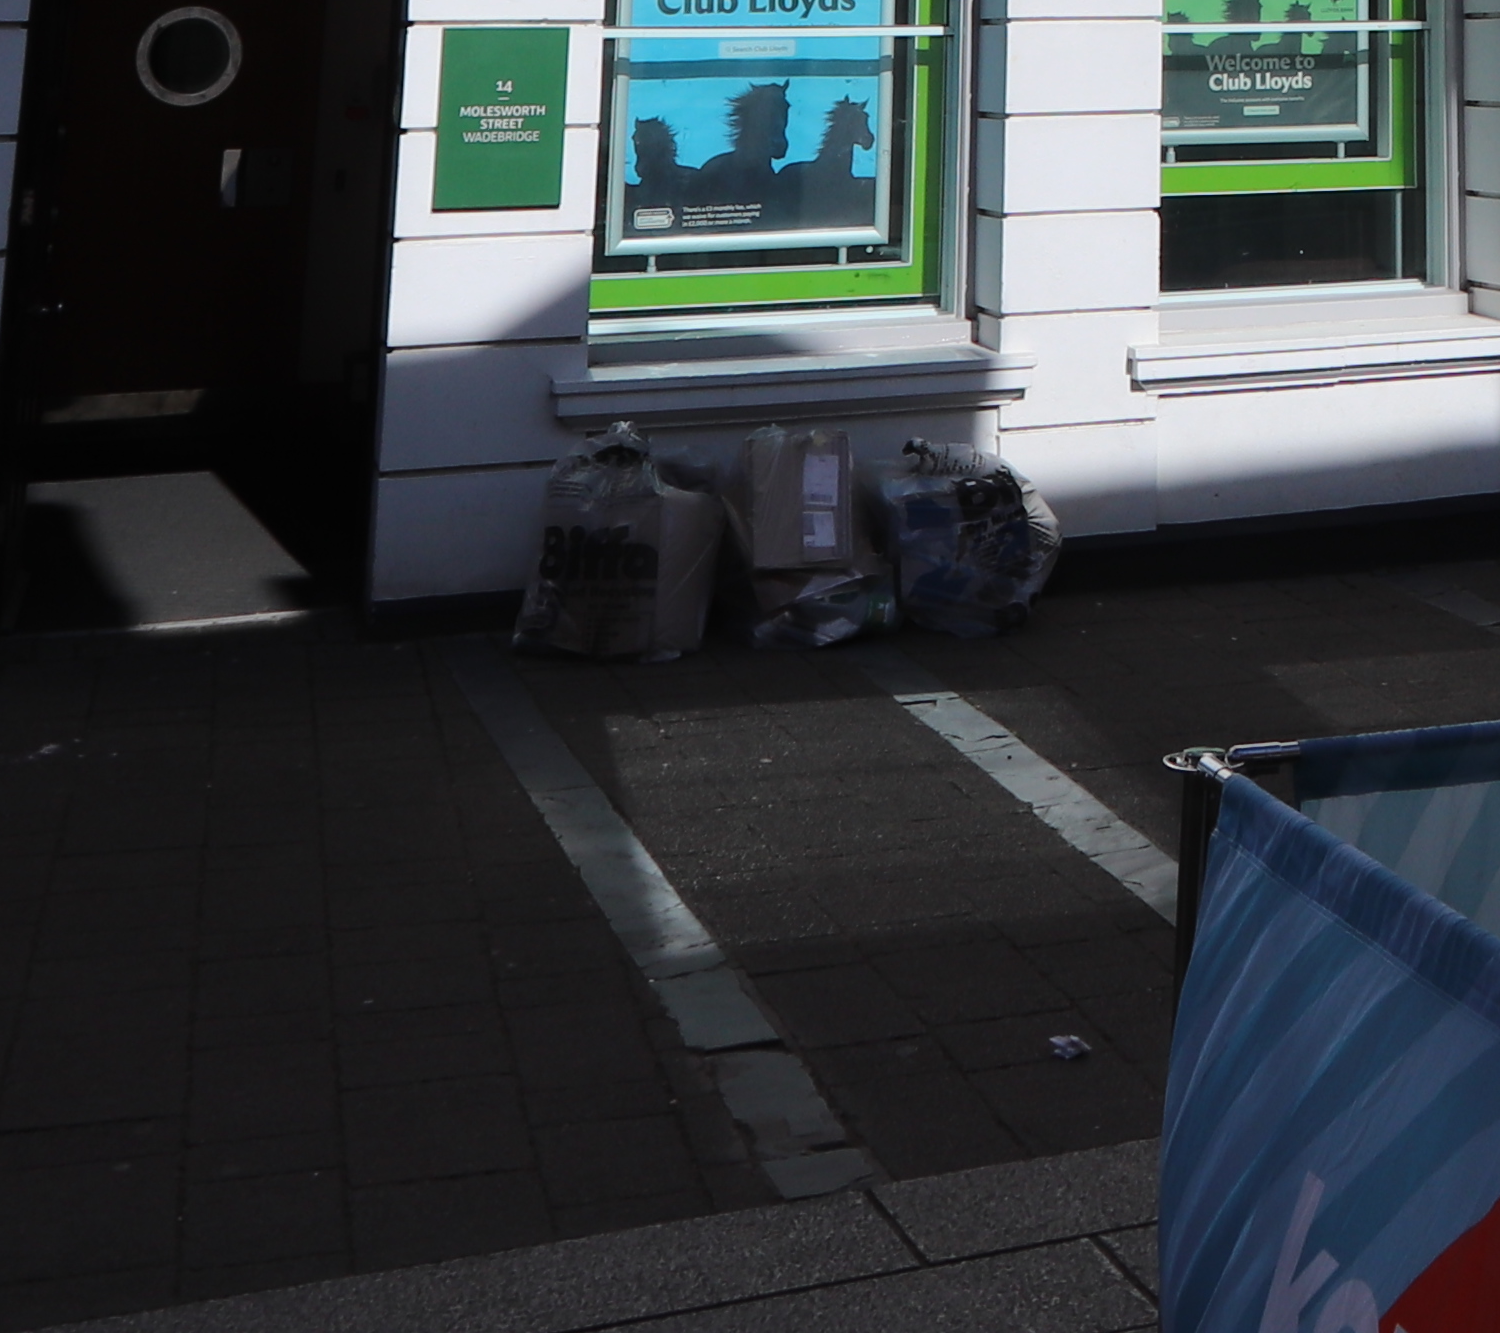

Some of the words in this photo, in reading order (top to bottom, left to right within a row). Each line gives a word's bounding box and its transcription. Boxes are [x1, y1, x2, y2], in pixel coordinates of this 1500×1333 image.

[1206, 53, 1291, 72] Welcome
[1295, 54, 1315, 70] to
[495, 80, 513, 93] 14
[1208, 72, 1252, 92] Club
[1255, 71, 1313, 93] Lloyds
[459, 105, 546, 118] MOLESWORTH
[479, 118, 524, 130] STREET
[462, 131, 540, 143] WADEBRIDGE
[538, 525, 659, 580] Biffa
